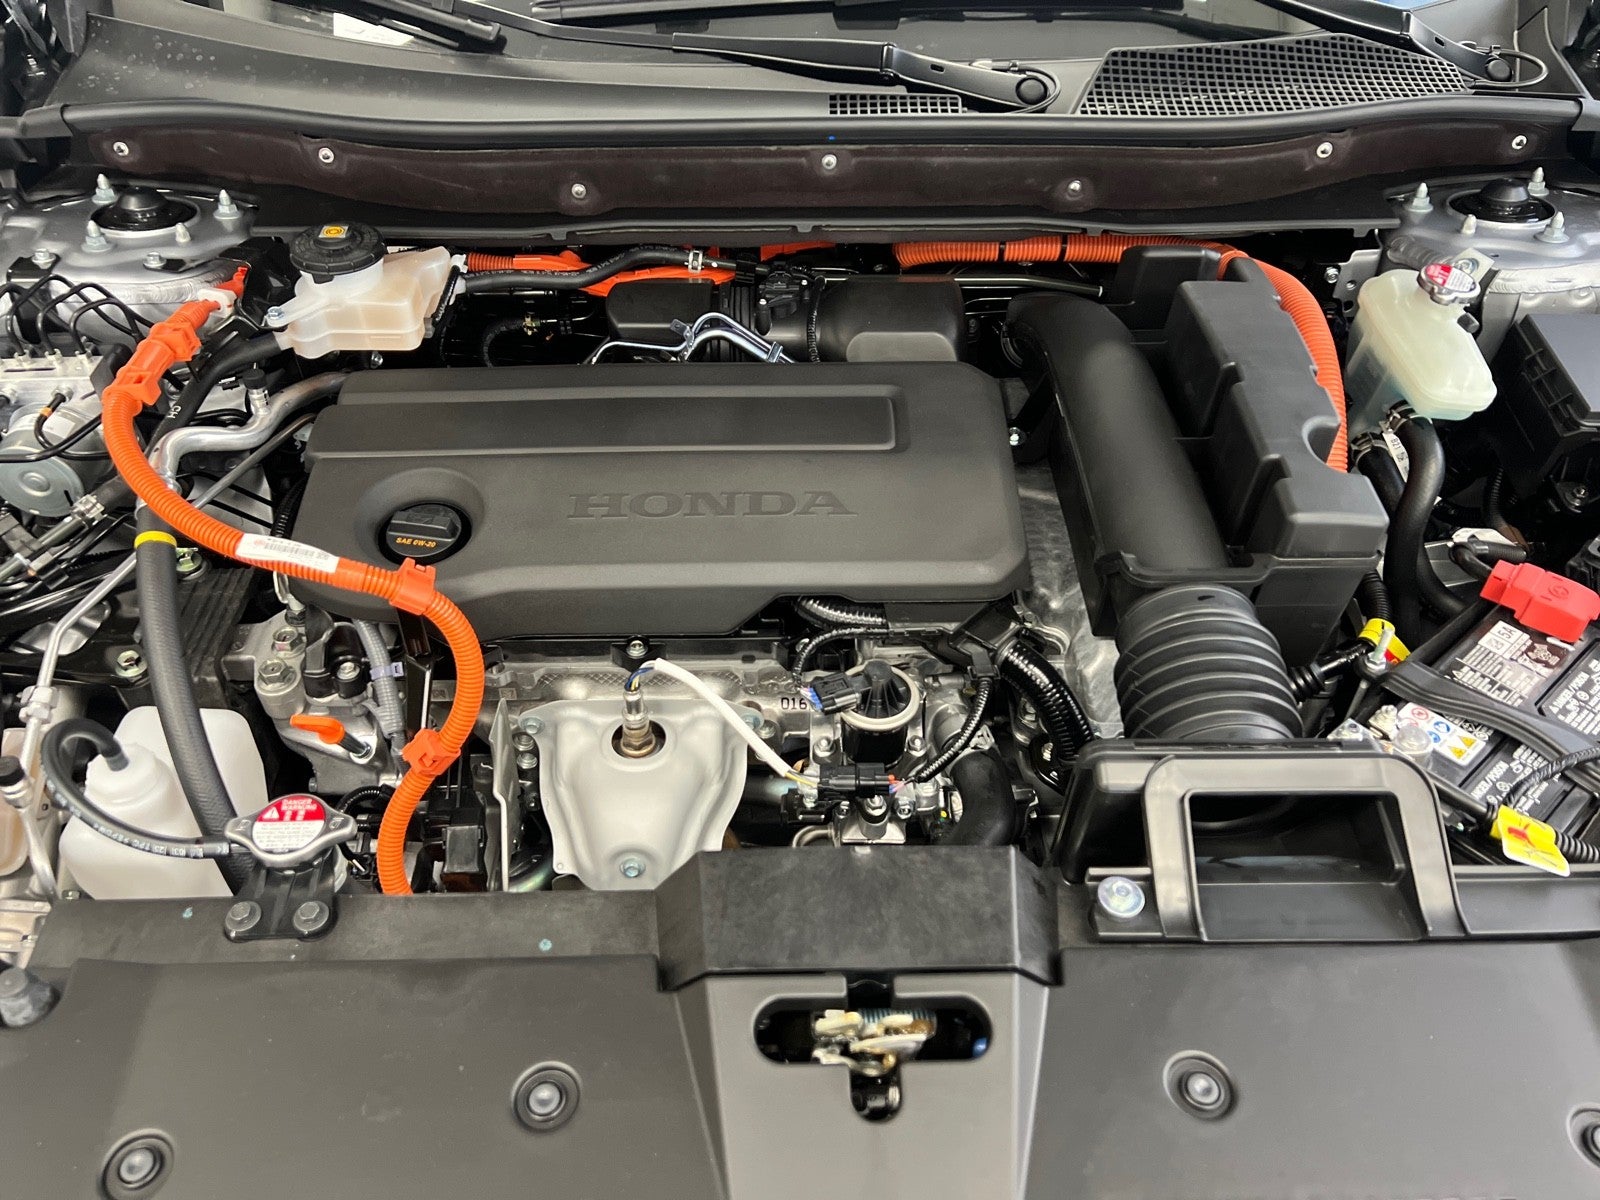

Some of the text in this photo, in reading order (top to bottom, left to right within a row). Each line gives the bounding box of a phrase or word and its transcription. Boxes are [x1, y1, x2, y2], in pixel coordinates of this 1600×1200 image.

[567, 490, 859, 520] HONDA
[395, 537, 437, 548] SAE 0W-20
[1497, 626, 1517, 639] 5A
